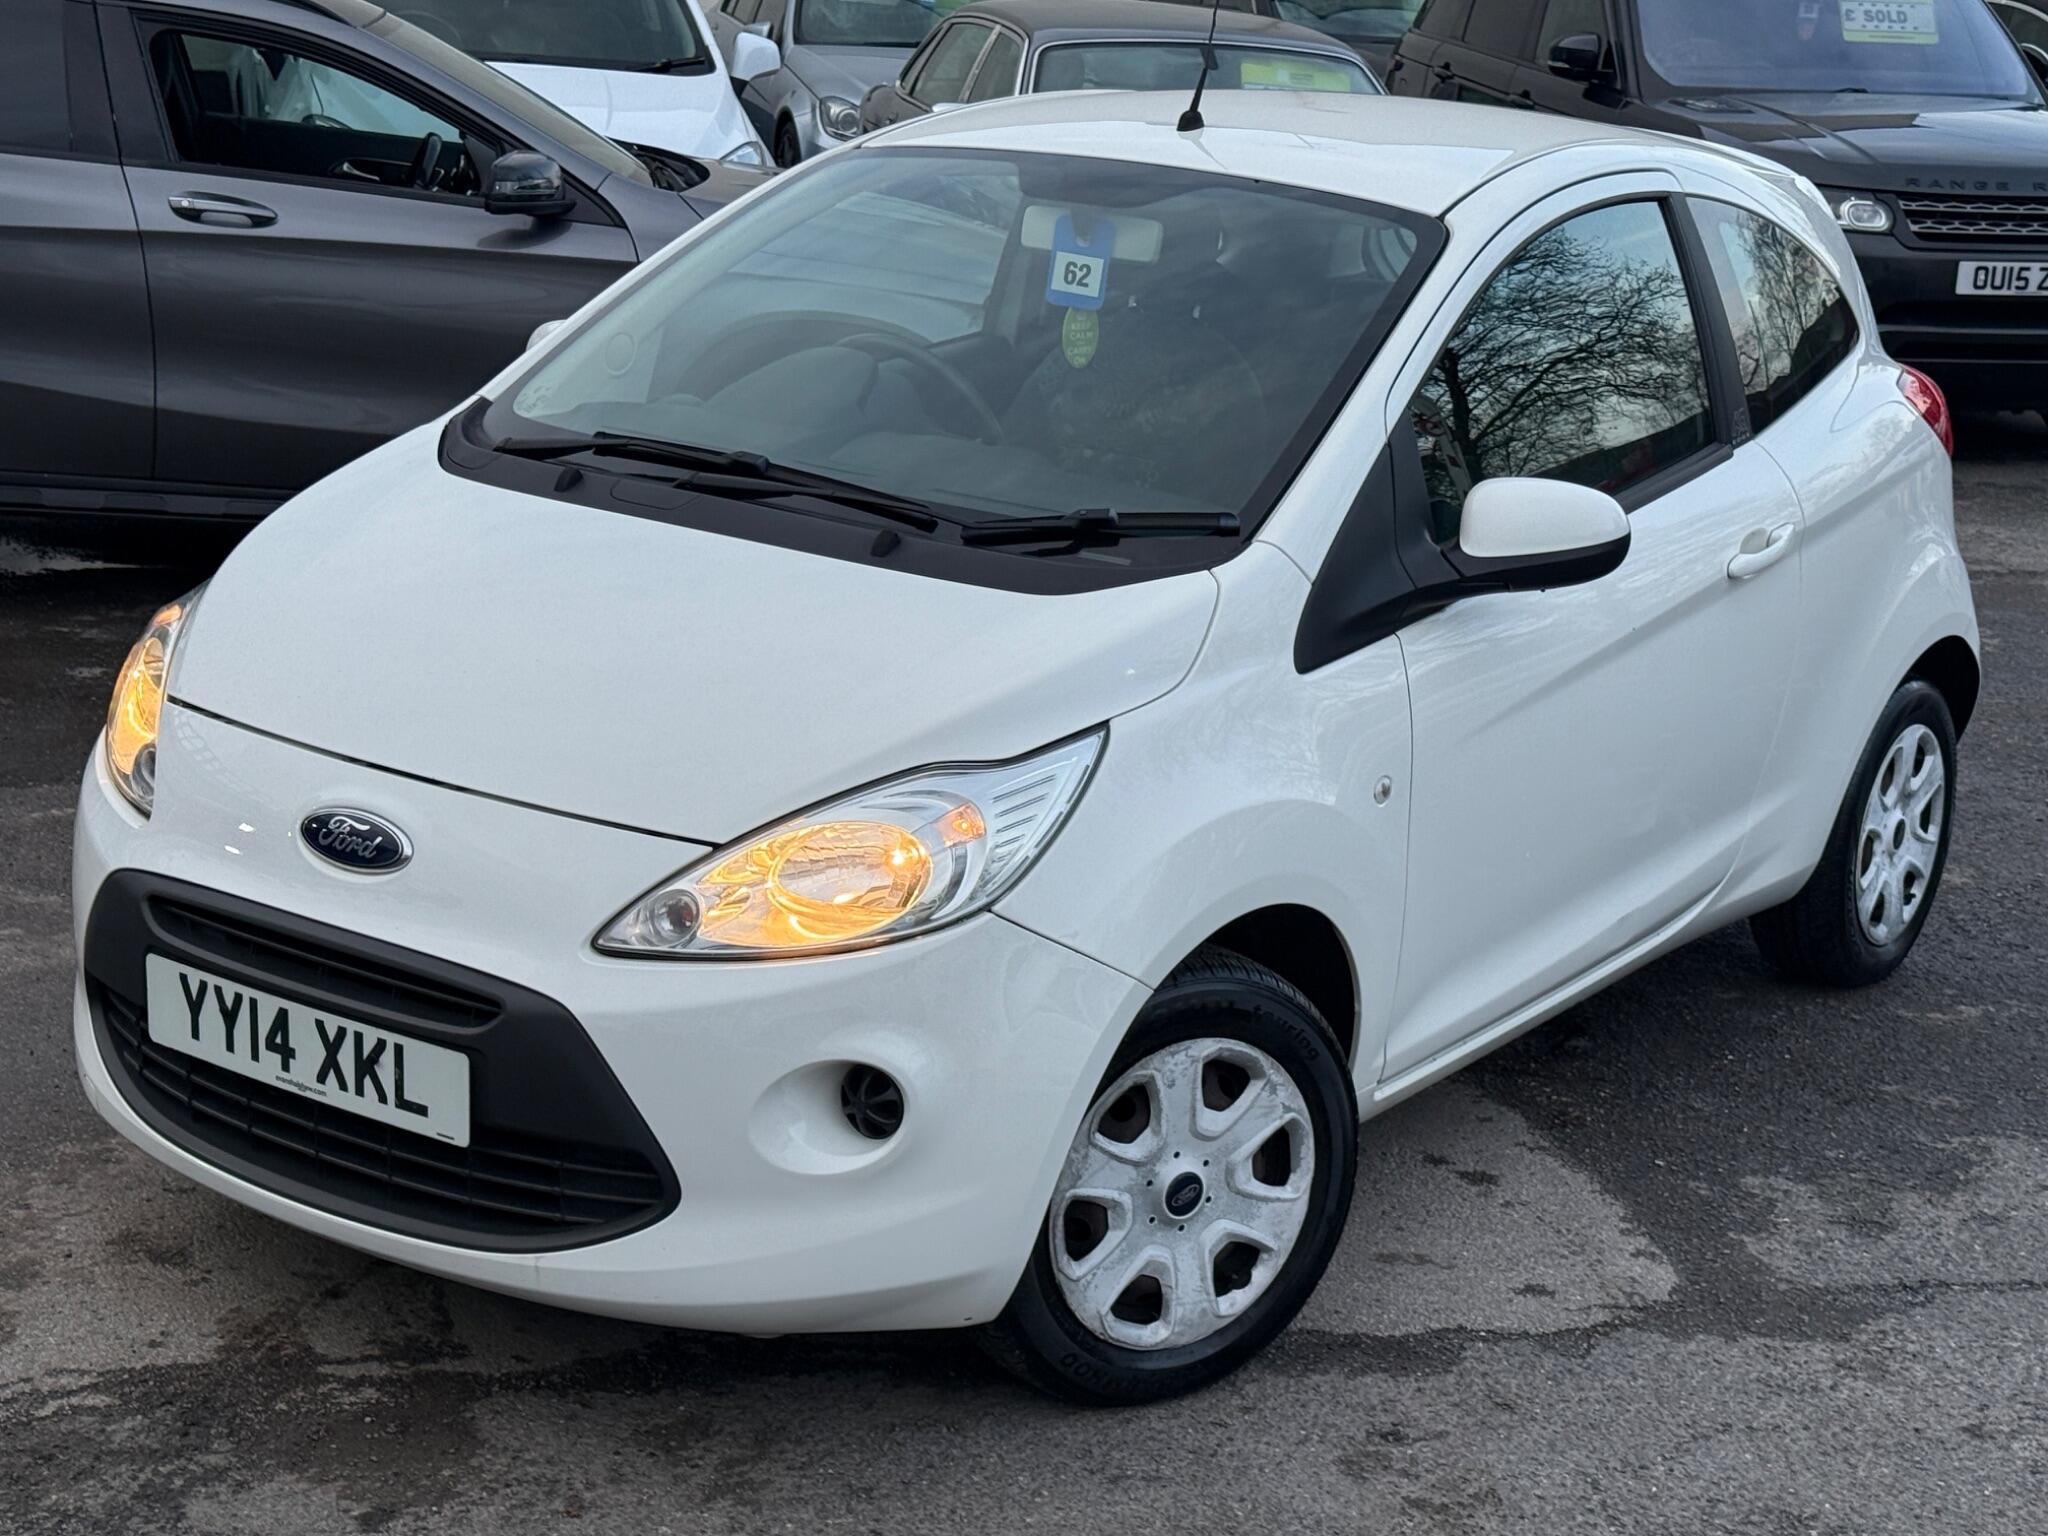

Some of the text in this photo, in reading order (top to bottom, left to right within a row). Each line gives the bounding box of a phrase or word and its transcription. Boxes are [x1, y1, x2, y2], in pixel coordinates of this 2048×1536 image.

[1862, 9, 1908, 24] SOLD
[1904, 177, 2010, 192] RANGE
[1063, 260, 1092, 288] 62
[1973, 265, 2031, 290] OU15
[318, 815, 383, 858] Ford
[179, 972, 429, 1118] YY14 XKL
